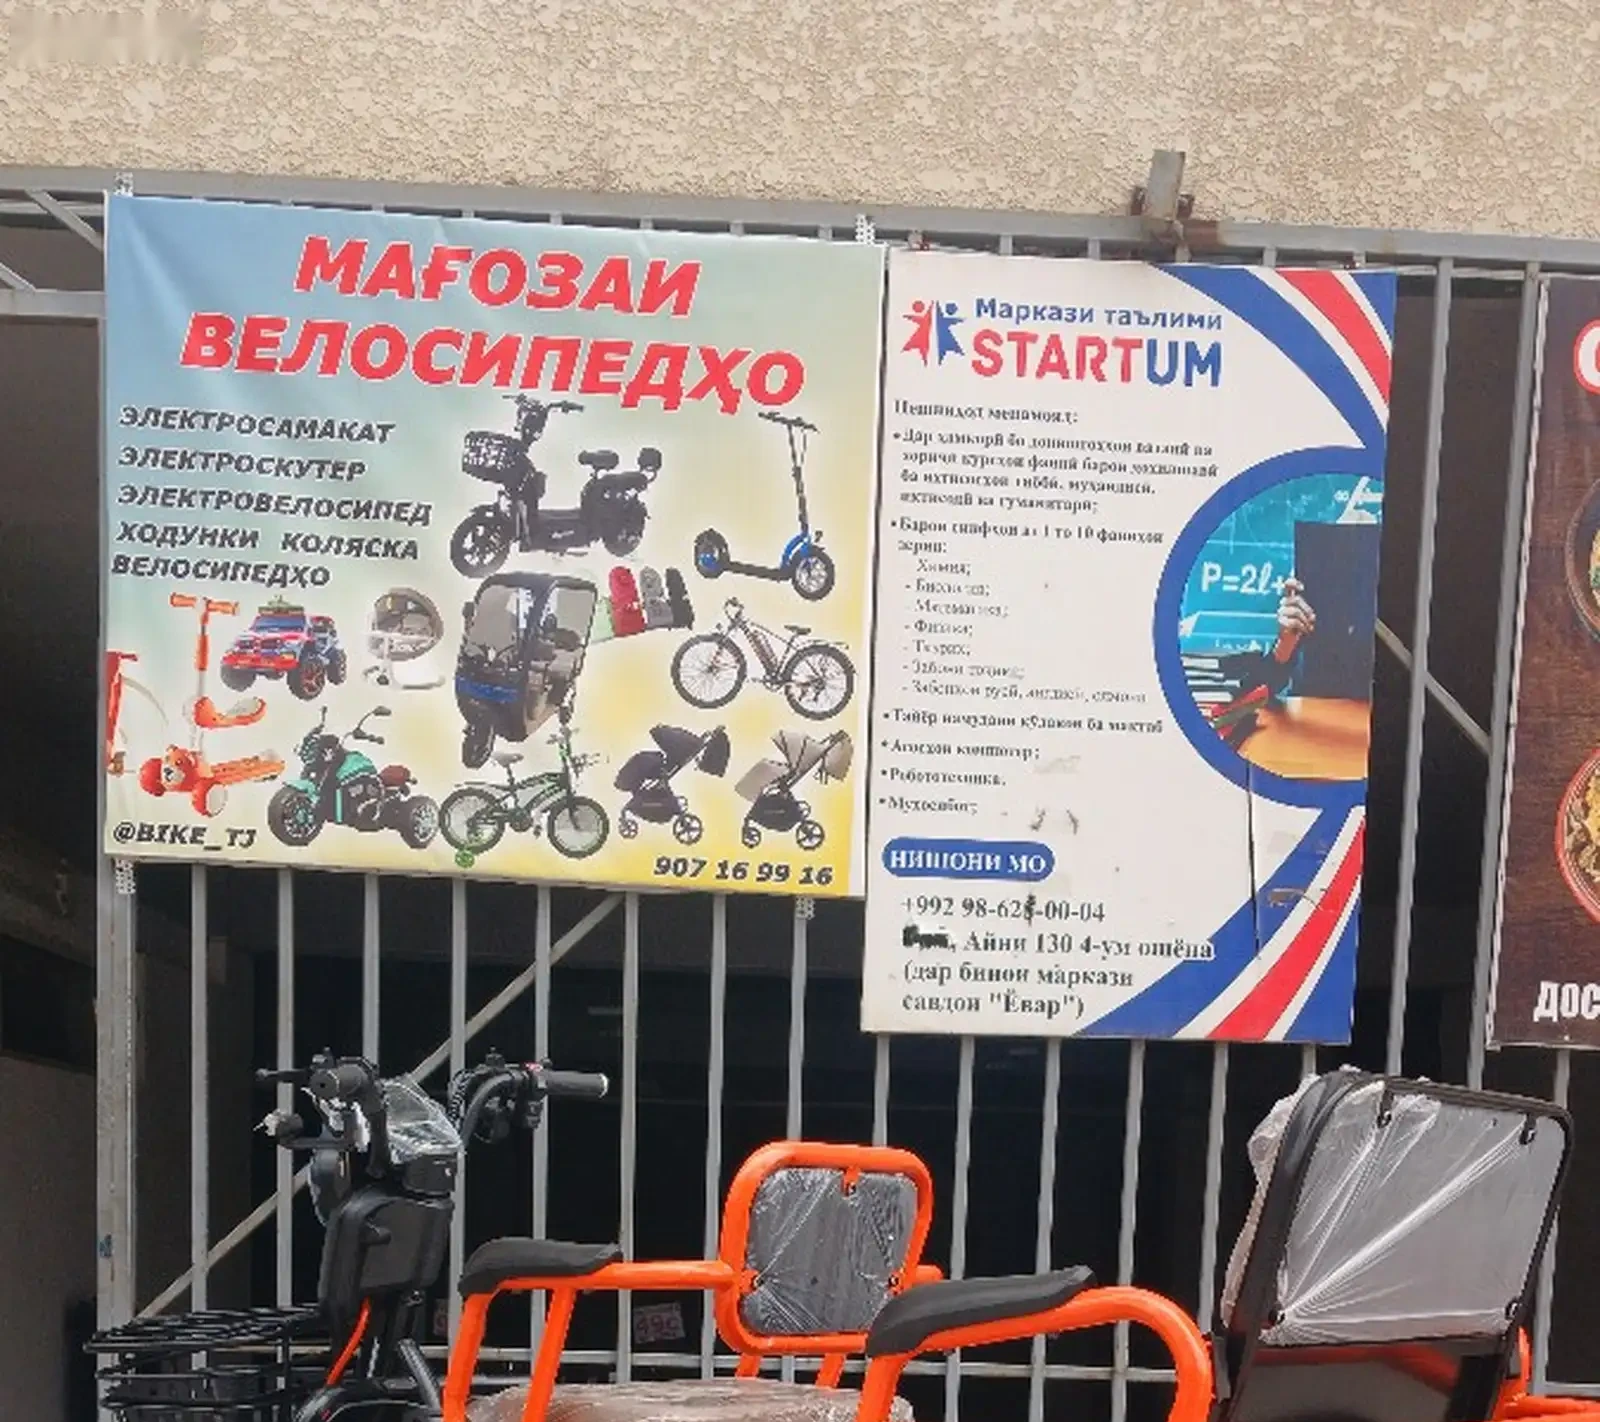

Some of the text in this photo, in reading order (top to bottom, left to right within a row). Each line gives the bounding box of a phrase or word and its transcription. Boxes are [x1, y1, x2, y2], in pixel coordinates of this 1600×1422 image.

[294, 235, 702, 317] МАҒОЗАИ
[976, 298, 1223, 330] Маркази таълими
[180, 312, 805, 414] ВЕЛОСИПЕДҲО
[971, 329, 1222, 387] STARTUM
[119, 406, 396, 444] ЭЛЕКТРОСАМАКАТ
[118, 446, 367, 482] ЭЛЕКТРОСКУТЕР
[118, 485, 432, 526] ЭЛЕКТРОВЕЛОСИПЕД
[116, 521, 420, 560] ХОДУНКИ КОЛЯСКА
[113, 822, 257, 851] @BIKE_TJ
[654, 855, 833, 886] 907 16 99 16
[890, 849, 1047, 873] НИШОНИ МО
[901, 894, 954, 916] +992
[963, 930, 1027, 952] Айни
[1035, 932, 1073, 953] 130
